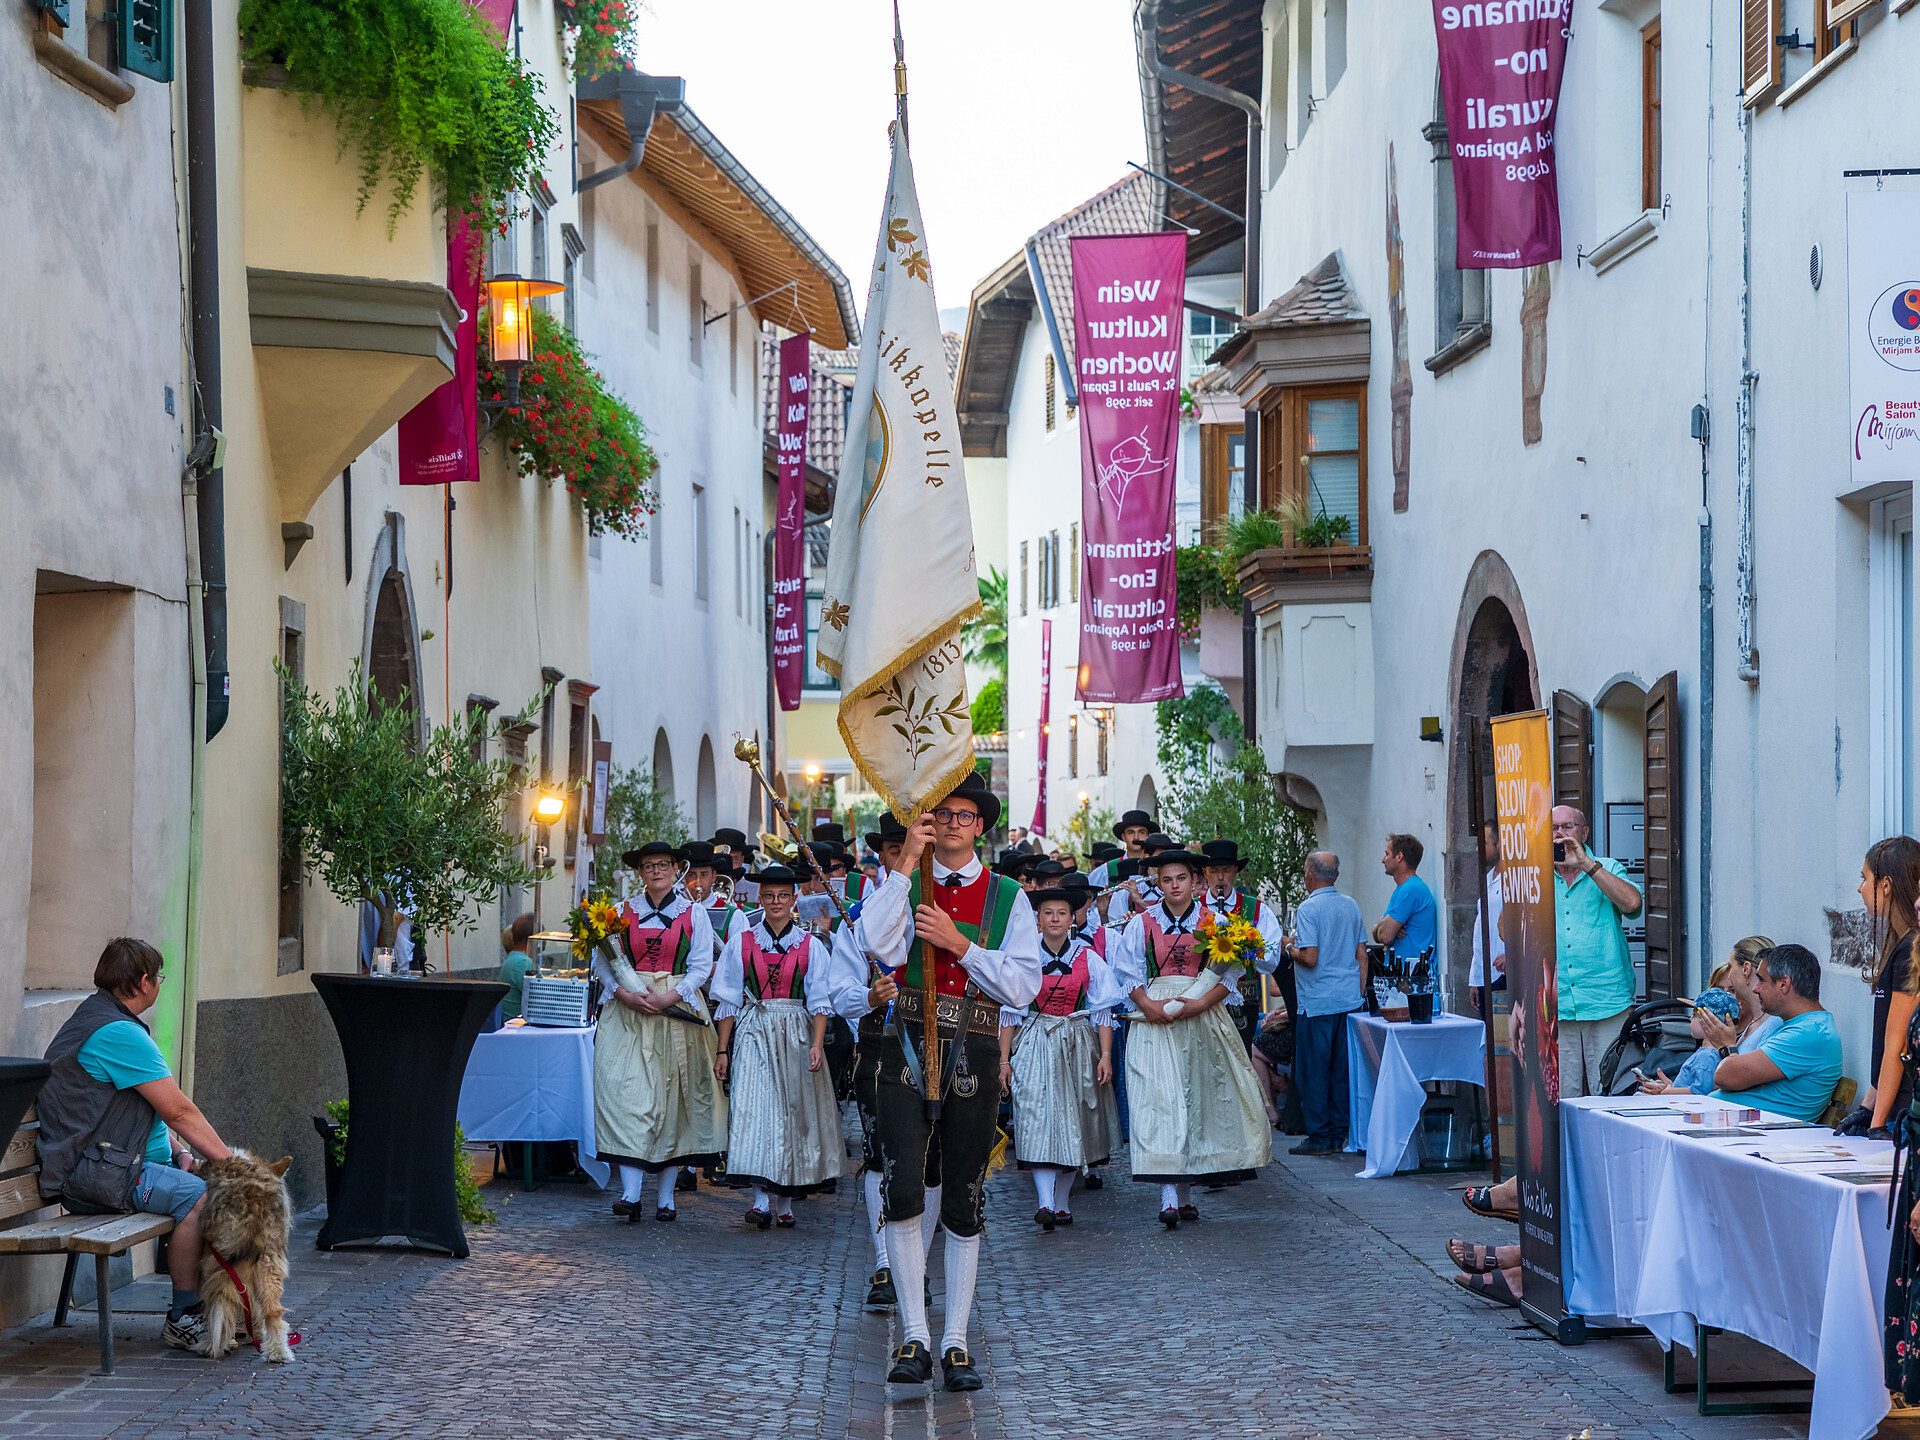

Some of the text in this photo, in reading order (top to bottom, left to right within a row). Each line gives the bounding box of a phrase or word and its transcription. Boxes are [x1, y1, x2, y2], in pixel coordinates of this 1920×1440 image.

[1878, 336, 1912, 346] Energie
[1882, 347, 1912, 356] Mirjam
[1886, 410, 1916, 419] Salon
[922, 640, 962, 680] 1813
[1499, 778, 1527, 817] SLOW
[1500, 823, 1528, 860] FOOD
[974, 1009, 998, 1026] 1963
